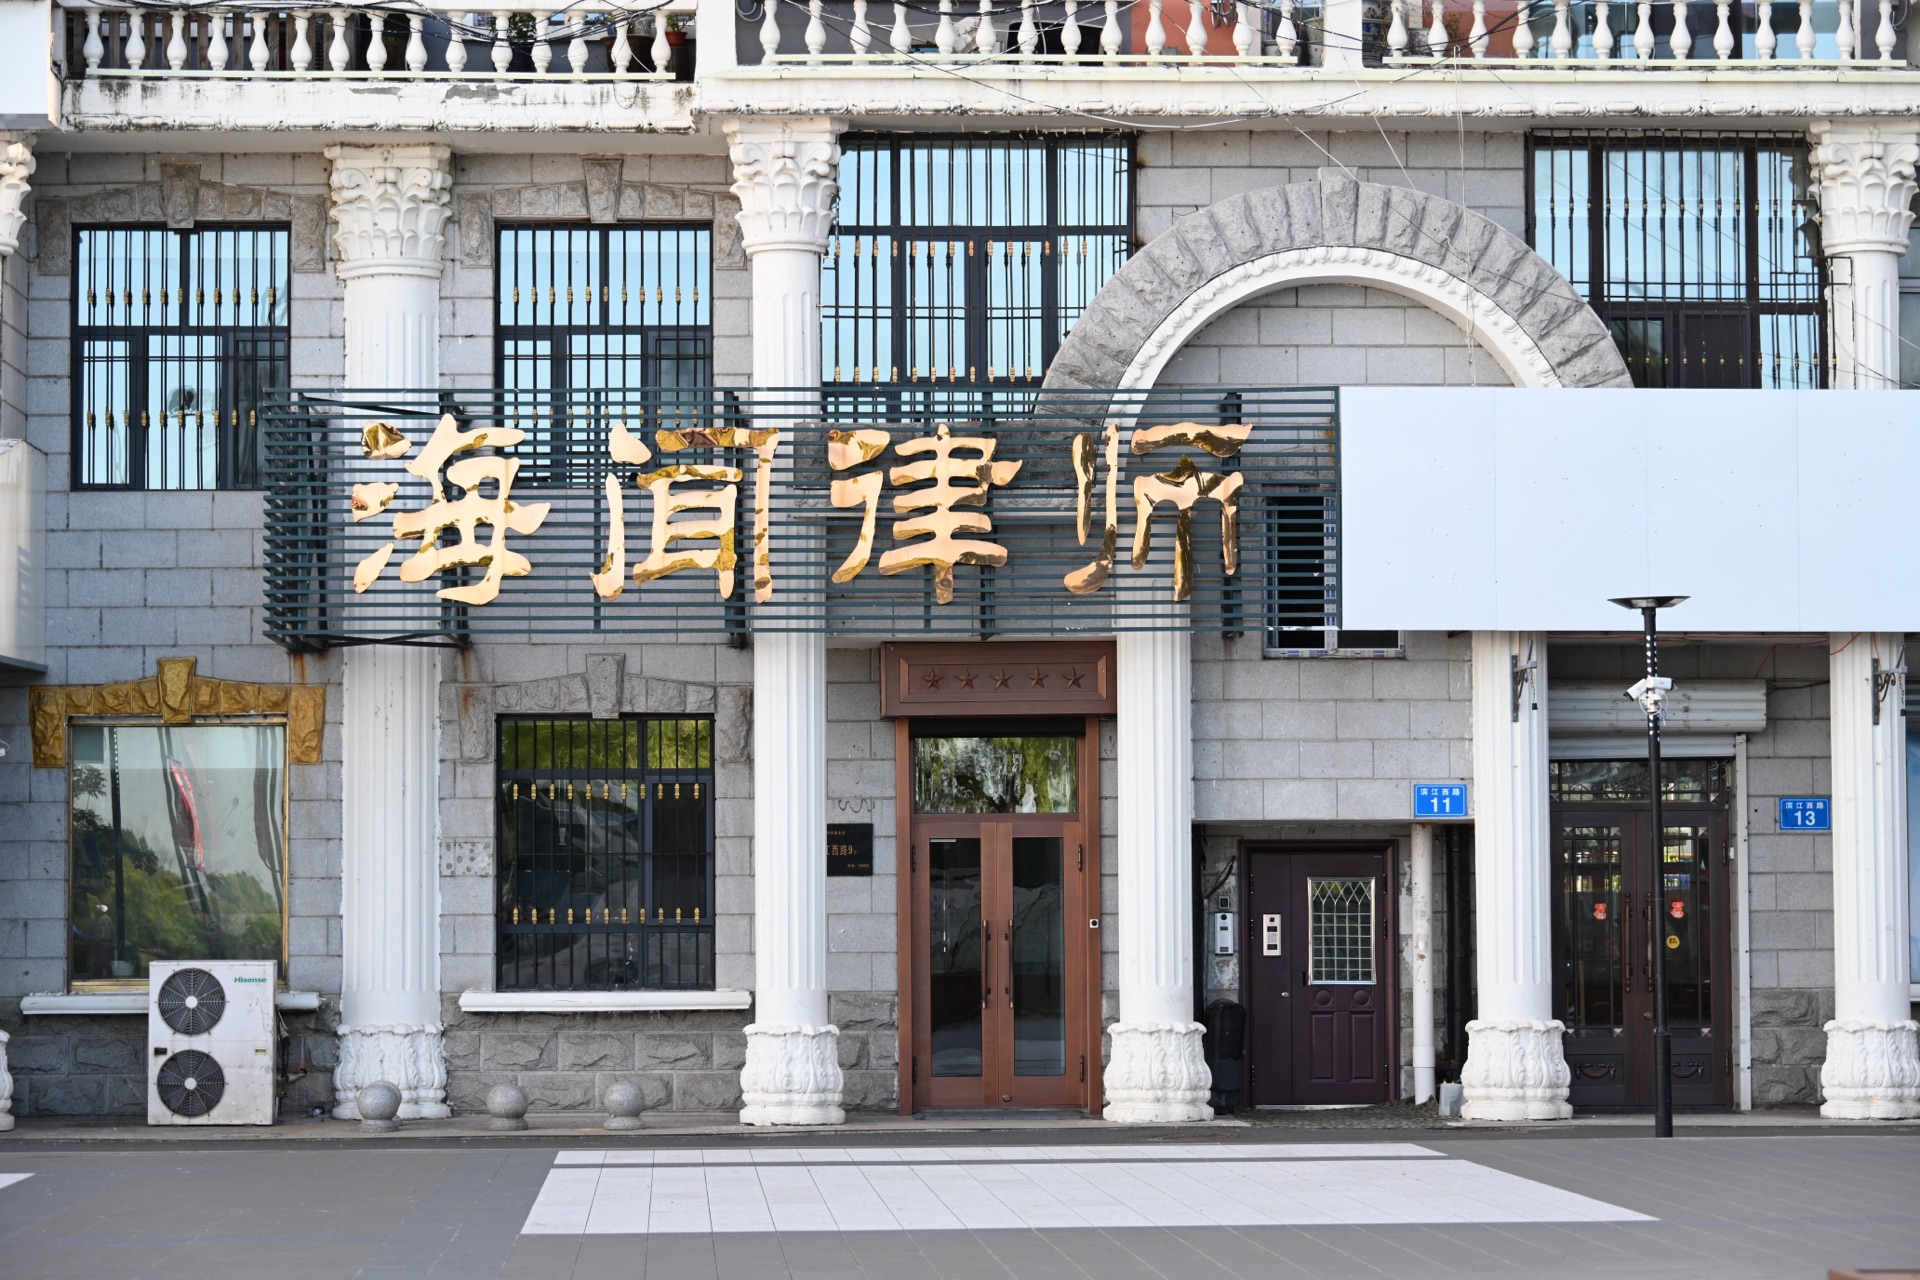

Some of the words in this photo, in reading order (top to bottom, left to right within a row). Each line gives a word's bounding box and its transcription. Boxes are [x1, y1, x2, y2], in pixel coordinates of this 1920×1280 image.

[1420, 787, 1461, 796] 滨江西路
[1430, 797, 1451, 813] 11
[1785, 801, 1824, 810] 滨江西路
[1794, 810, 1816, 826] 13
